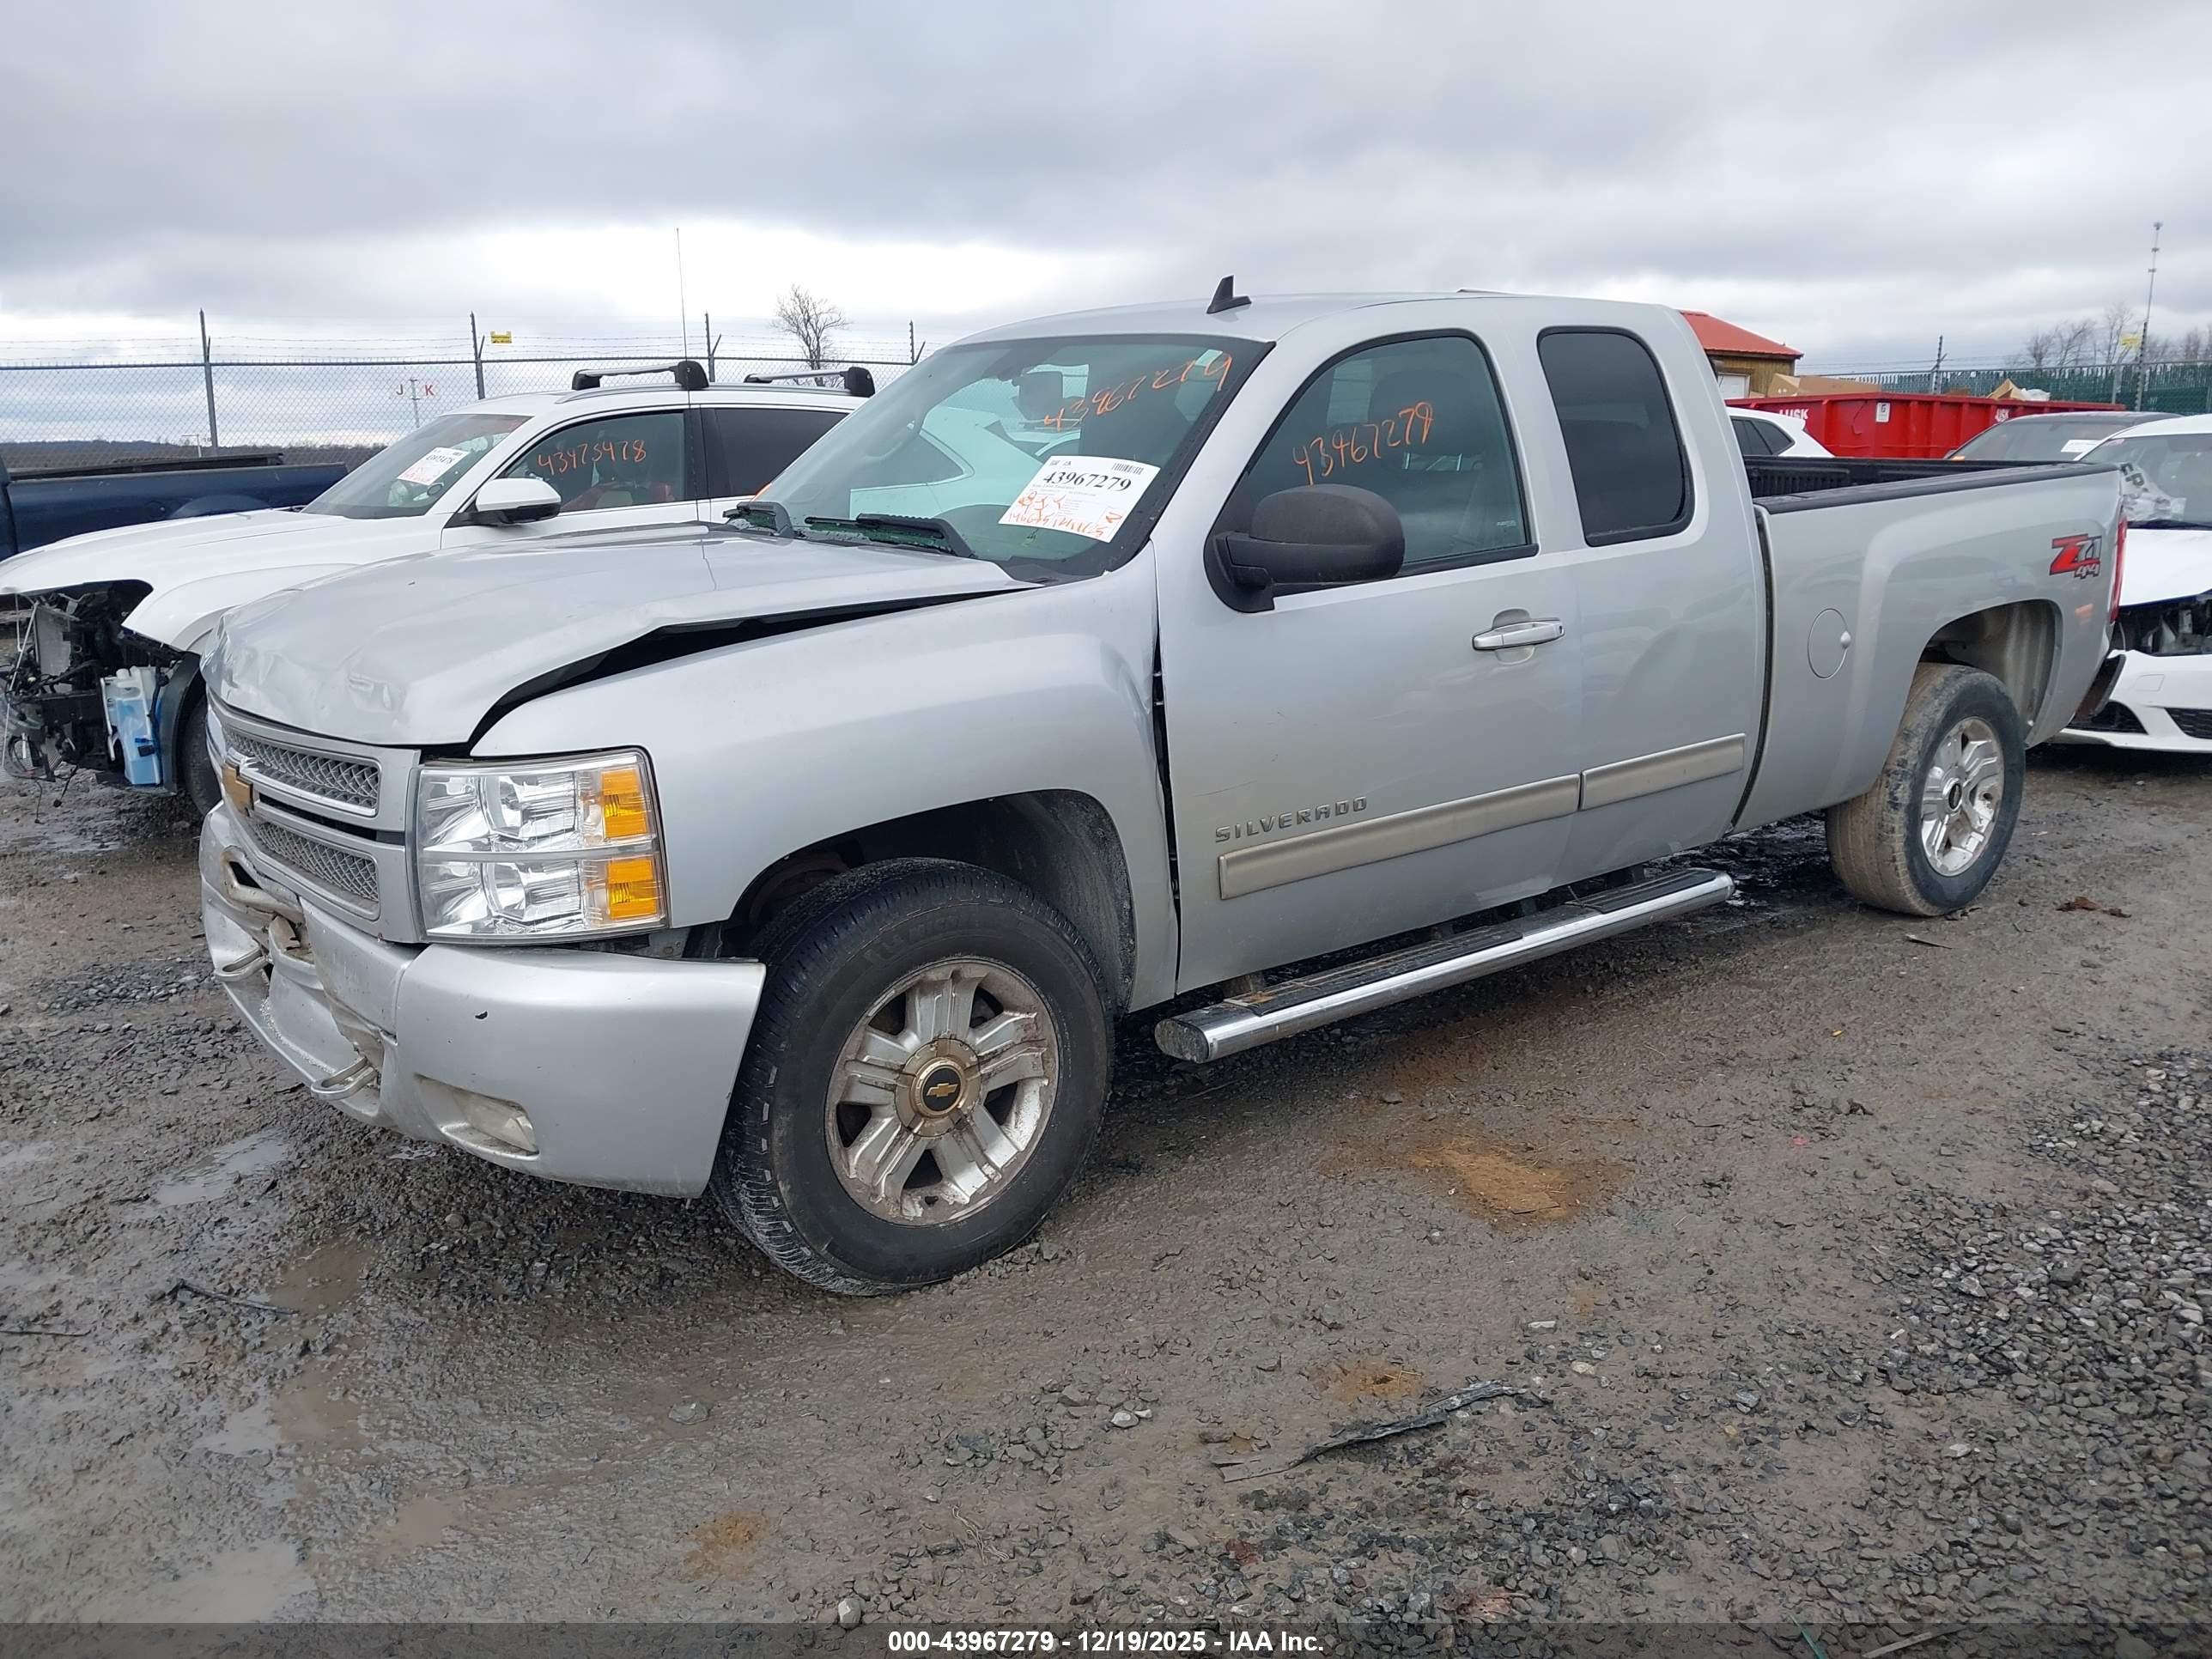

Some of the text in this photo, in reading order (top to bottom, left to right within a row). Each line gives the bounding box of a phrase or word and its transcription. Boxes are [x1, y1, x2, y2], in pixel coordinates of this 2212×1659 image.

[396, 384, 434, 396] J K
[1043, 471, 1132, 492] 43967279
[2049, 533, 2103, 576] Z71
[1215, 796, 1368, 843] SILVERADO
